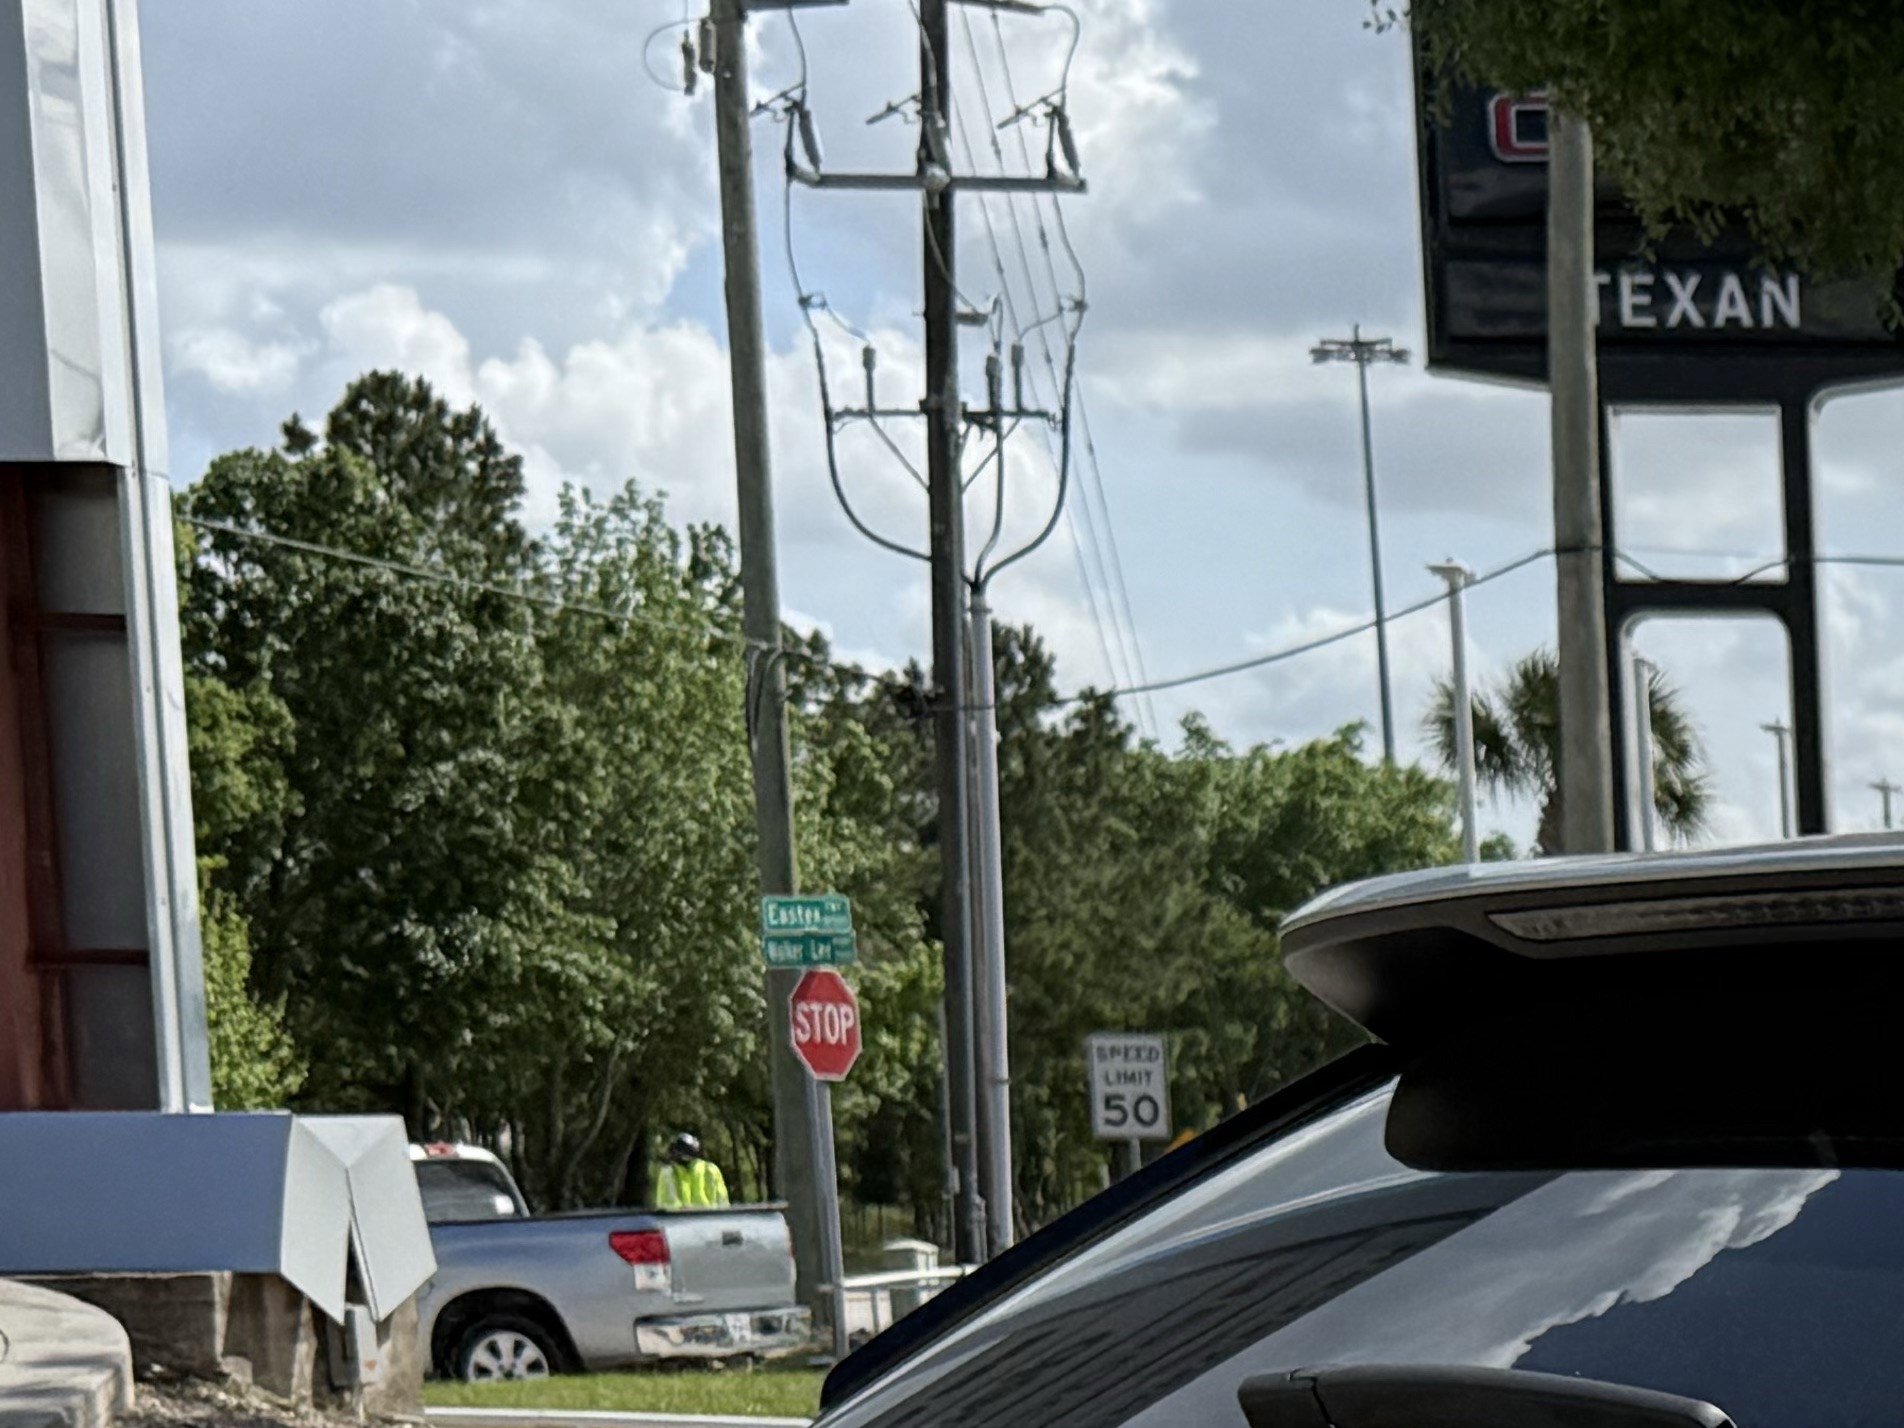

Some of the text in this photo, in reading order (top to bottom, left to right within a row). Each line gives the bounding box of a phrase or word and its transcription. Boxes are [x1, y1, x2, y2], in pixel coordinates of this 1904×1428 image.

[795, 1001, 855, 1046] STOP
[1096, 1045, 1159, 1063] SPEED
[1104, 1068, 1153, 1087] LIMIT
[1103, 1091, 1160, 1128] 50
